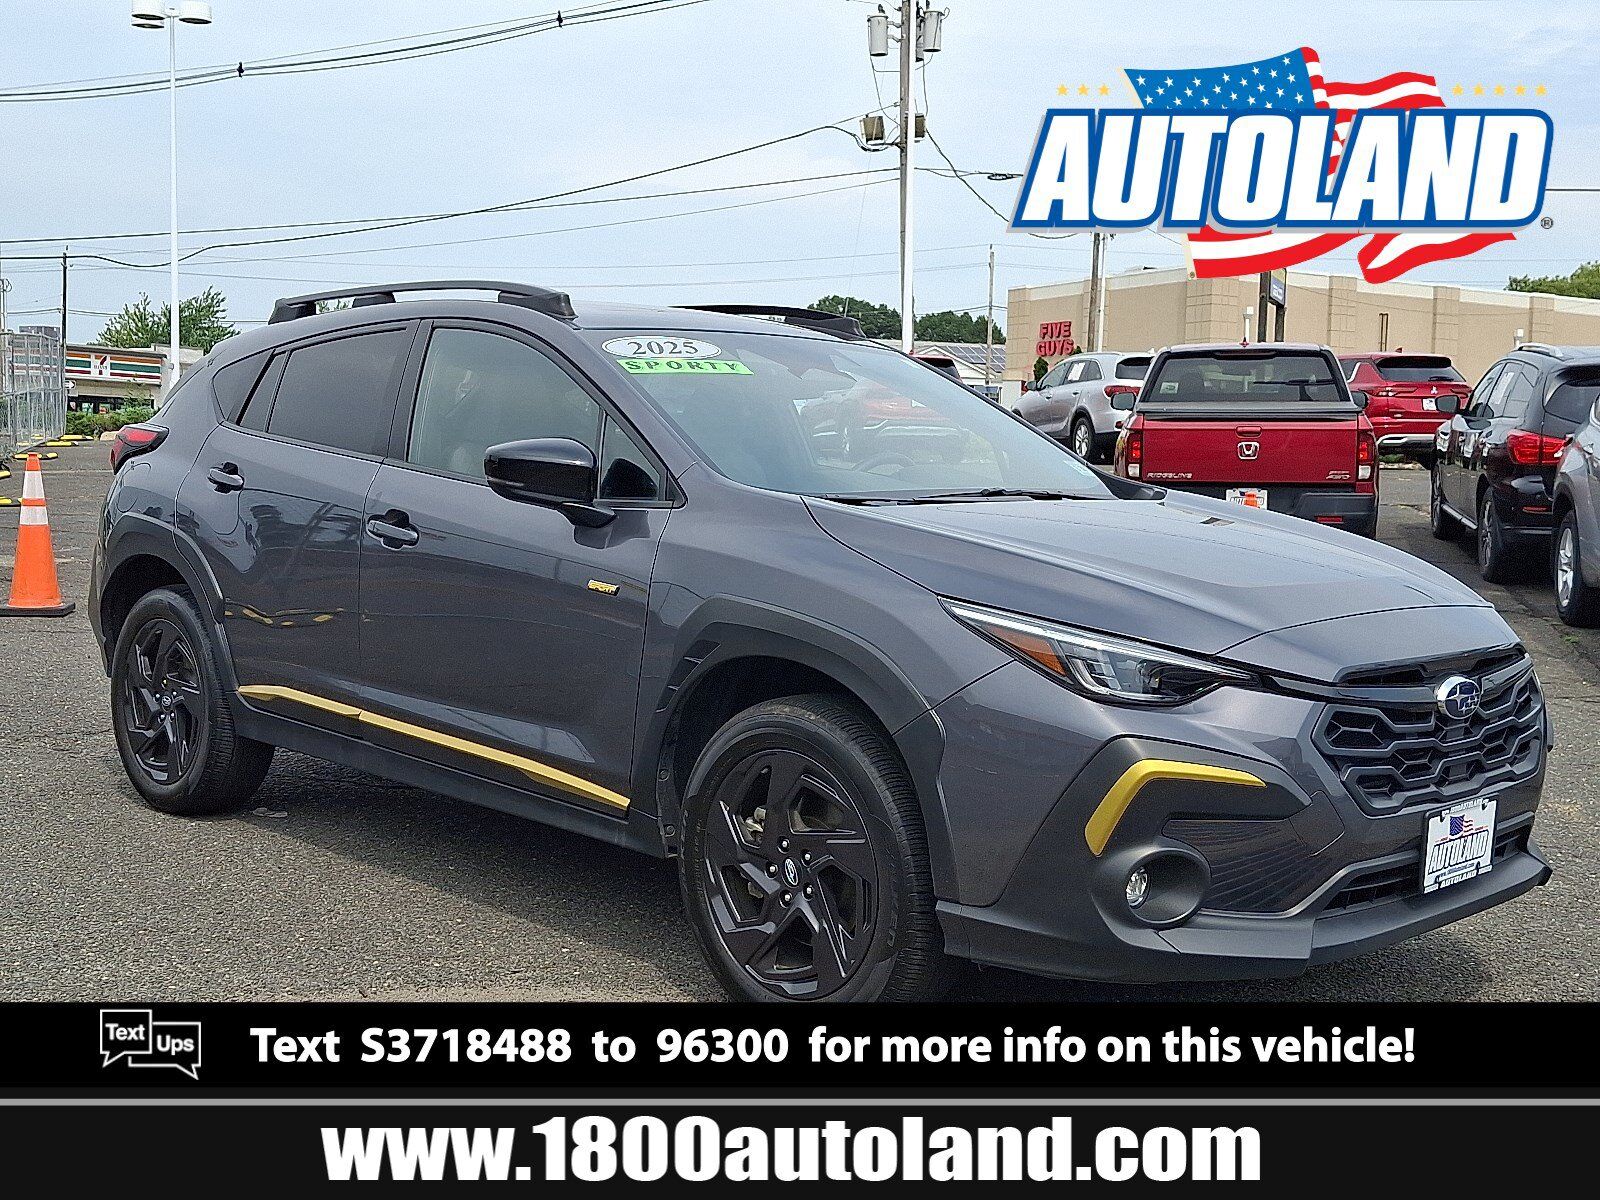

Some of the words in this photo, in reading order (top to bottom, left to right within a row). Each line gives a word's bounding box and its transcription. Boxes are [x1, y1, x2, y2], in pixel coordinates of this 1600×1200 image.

[1040, 321, 1072, 339] FIVE
[627, 341, 699, 355] 2025
[1036, 339, 1074, 357] GUYS
[625, 360, 738, 371] SPORTY
[1428, 831, 1489, 874] AUTOLAND
[1440, 870, 1477, 889] AUTOLAND
